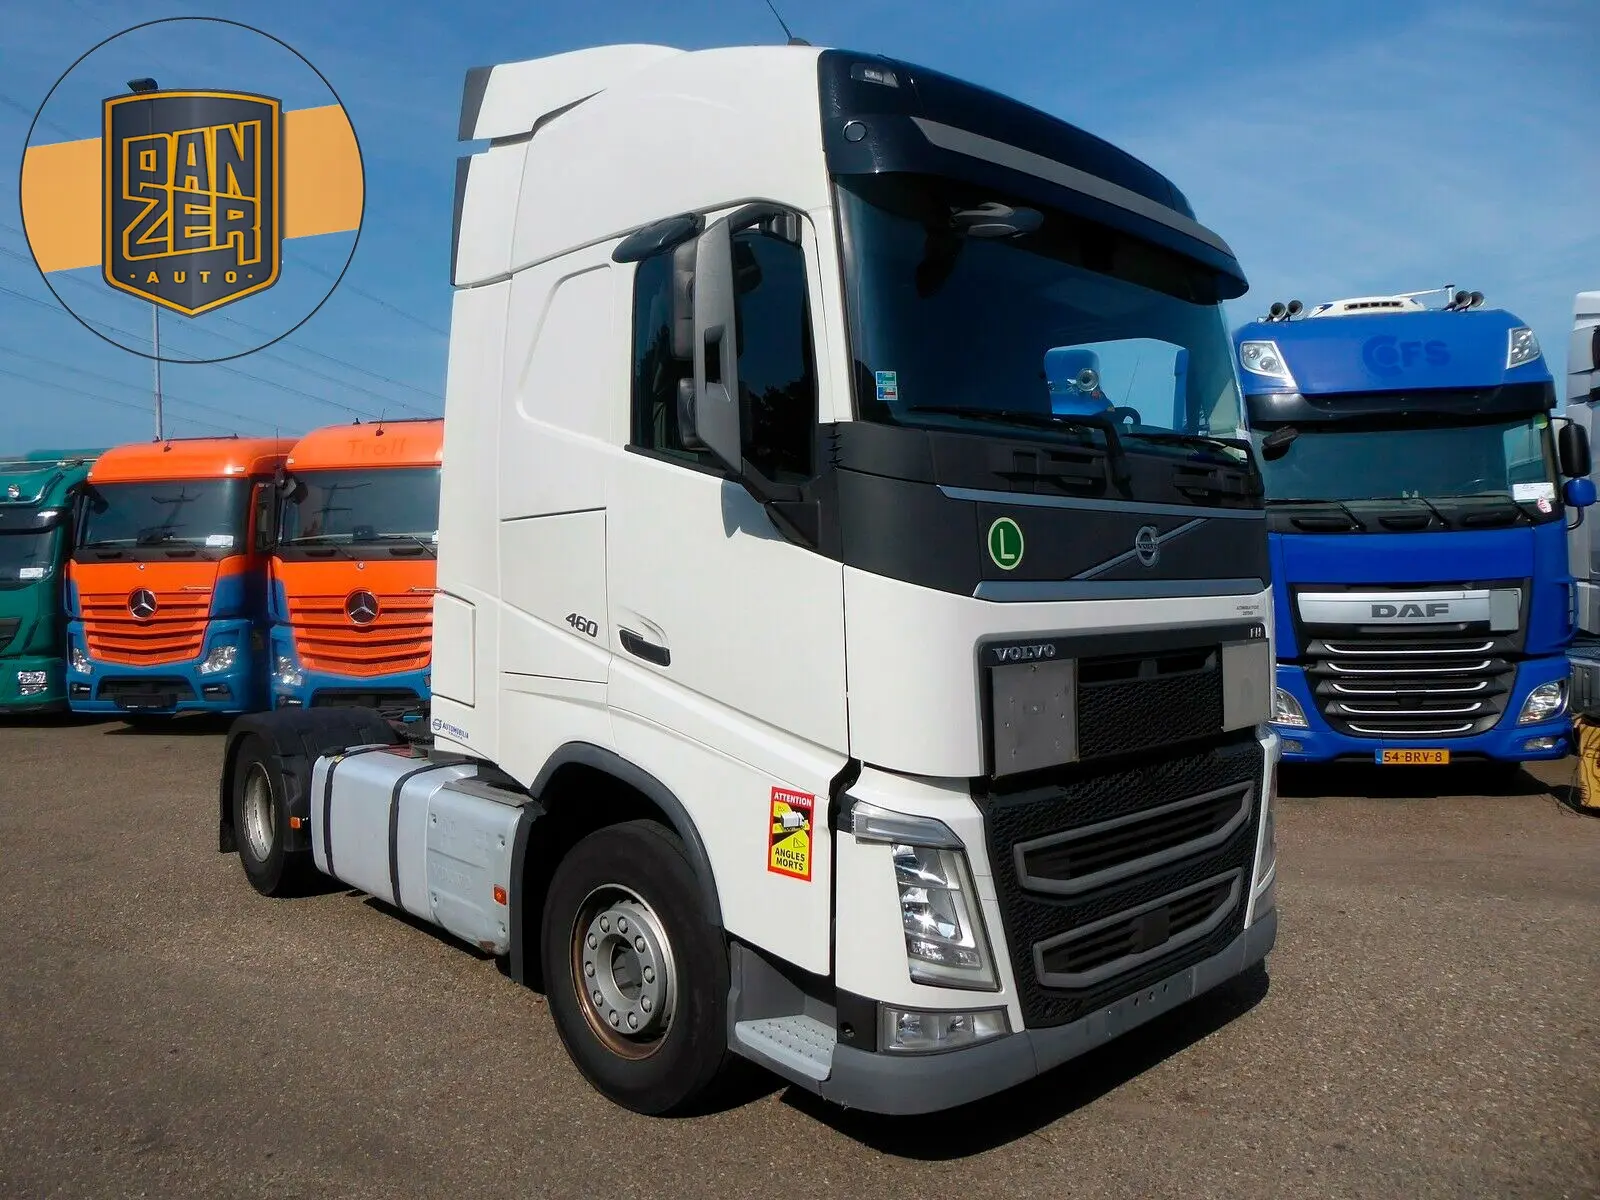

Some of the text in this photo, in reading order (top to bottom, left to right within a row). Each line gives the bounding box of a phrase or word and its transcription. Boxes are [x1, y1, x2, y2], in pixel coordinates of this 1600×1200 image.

[999, 528, 1015, 559] L
[1371, 603, 1449, 617] DAF
[565, 613, 598, 637] 460
[992, 643, 1056, 661] VOLVO
[1383, 752, 1443, 762] 54-BRV-8
[774, 792, 812, 807] ATTENTION
[775, 848, 805, 862] ANGLES
[776, 858, 804, 871] MORTS
